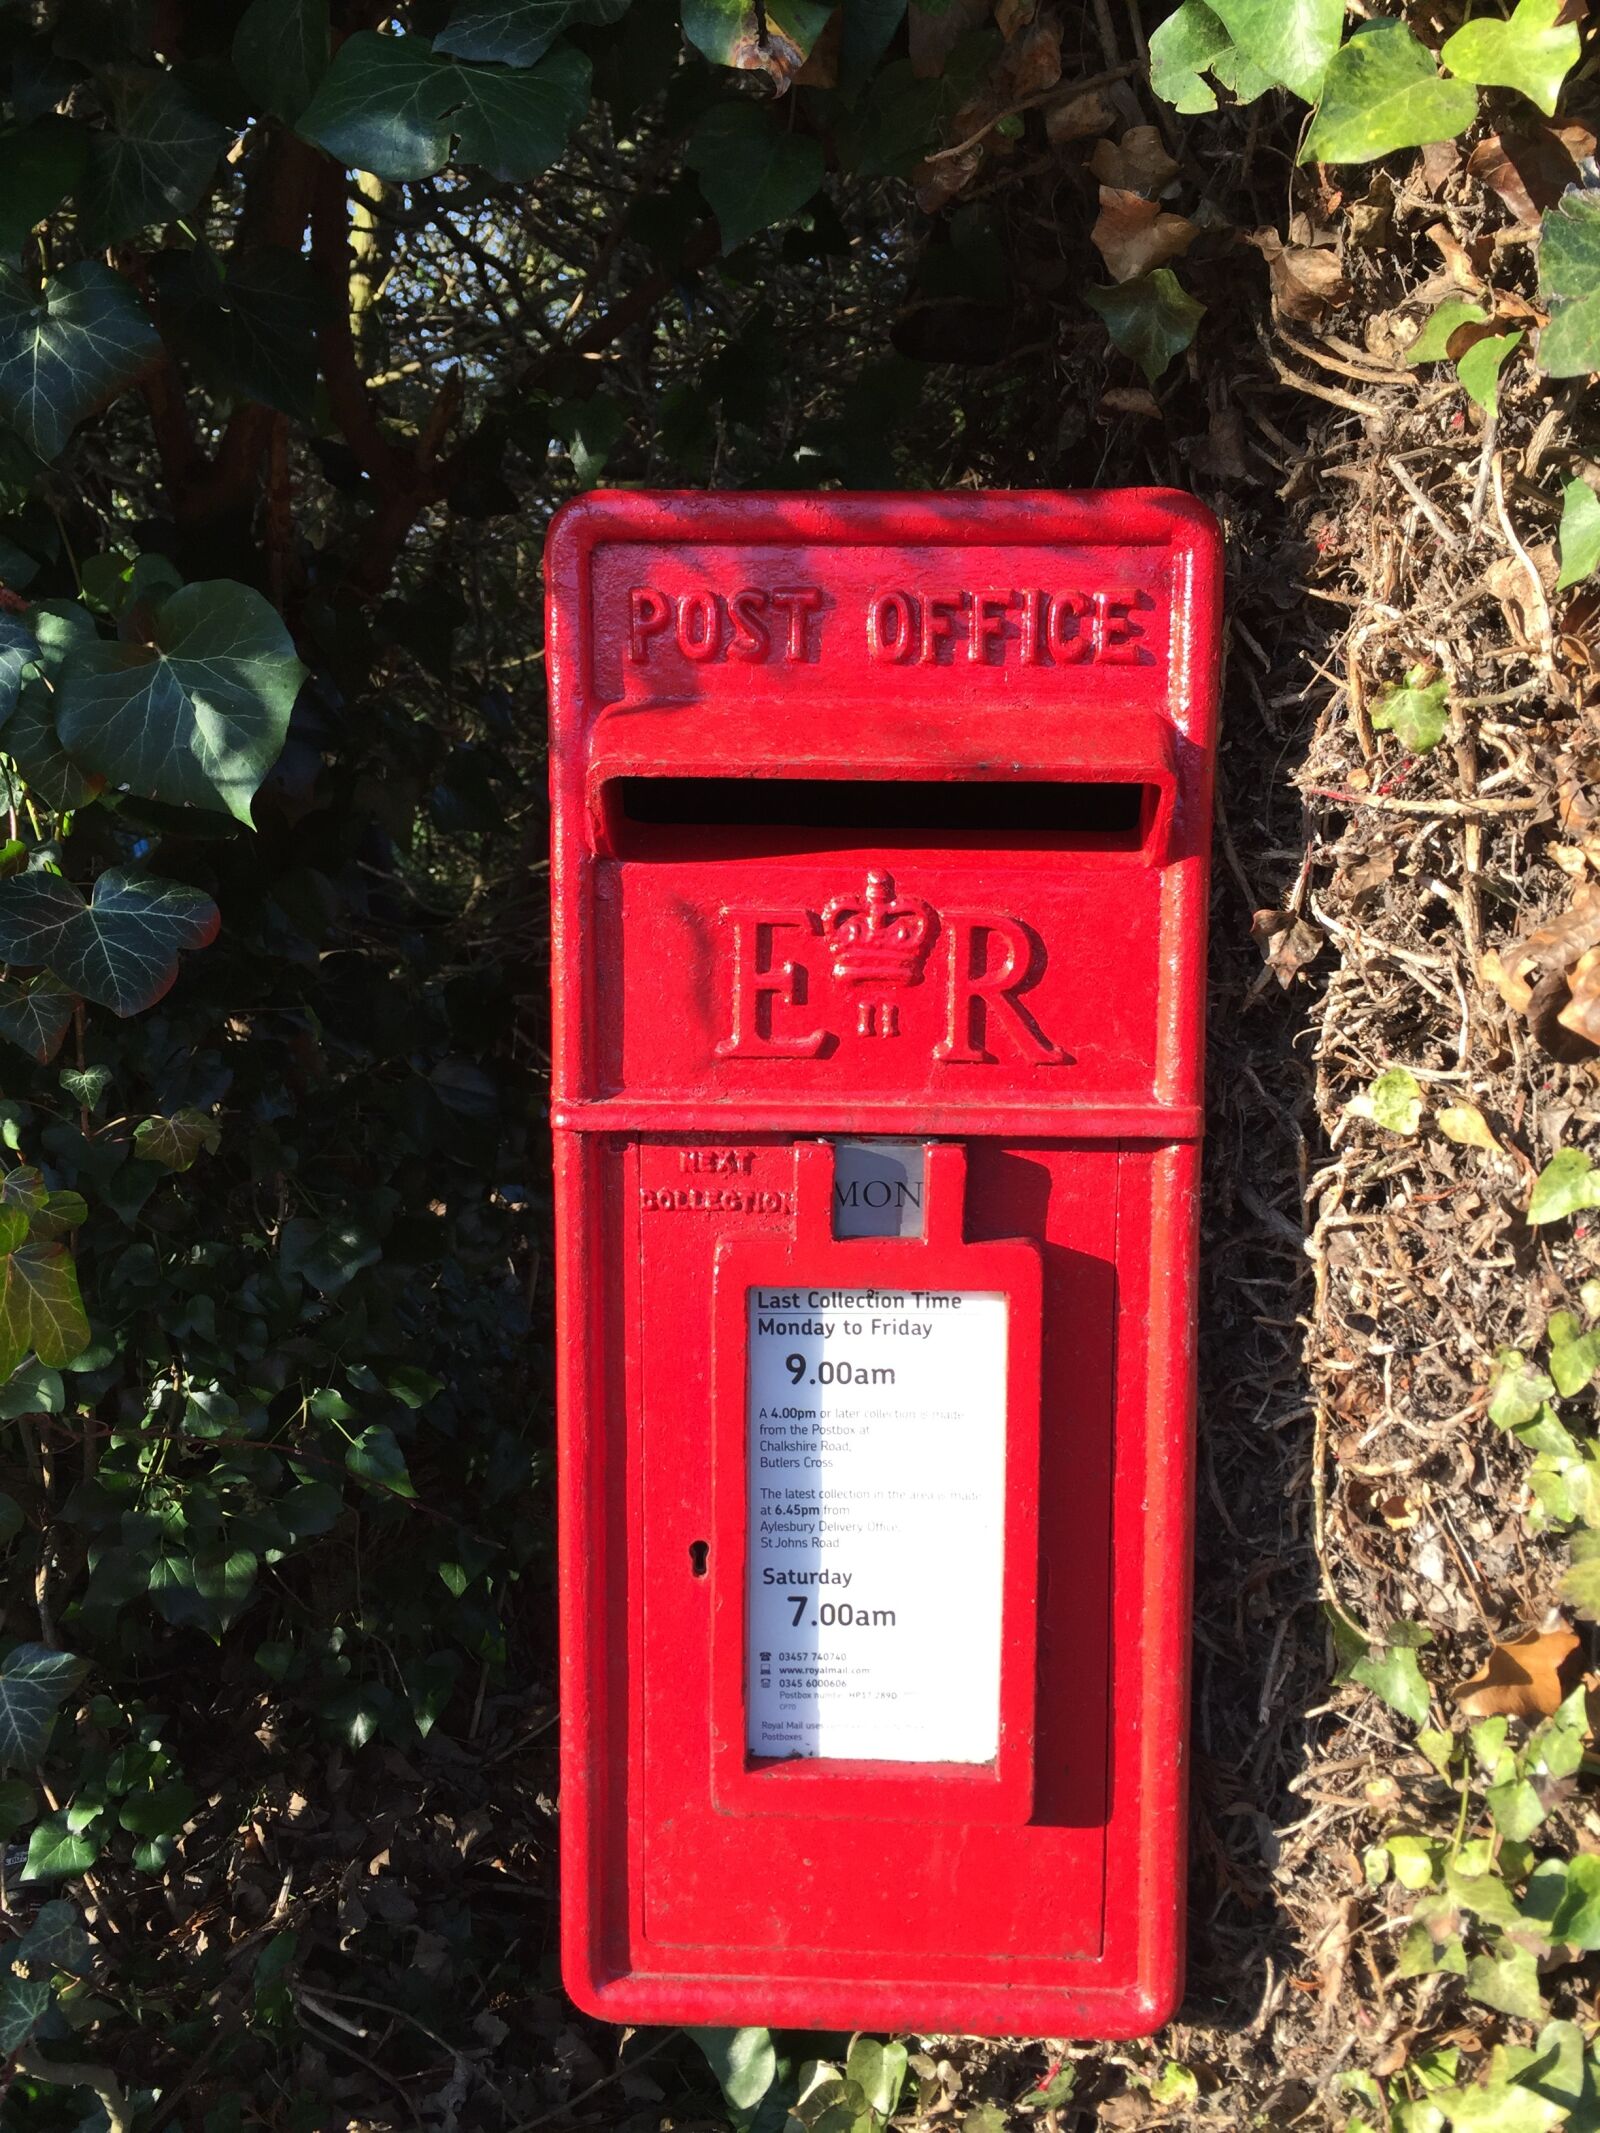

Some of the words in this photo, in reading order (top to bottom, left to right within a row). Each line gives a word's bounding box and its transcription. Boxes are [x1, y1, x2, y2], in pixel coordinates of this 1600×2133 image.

[628, 588, 826, 665] POST
[866, 589, 1154, 667] OFFICE
[716, 905, 838, 1060] E
[932, 907, 1076, 1066] R
[857, 1002, 899, 1038] II
[835, 1180, 924, 1208] MON
[757, 1292, 801, 1309] Last
[808, 1291, 905, 1309] Collection
[911, 1292, 962, 1310] Time
[757, 1319, 835, 1339] Monday
[844, 1320, 863, 1336] to
[871, 1319, 933, 1339] Friday
[785, 1353, 896, 1385] 9.00am
[759, 1408, 768, 1419] A
[770, 1408, 816, 1421] 4.00pm
[819, 1410, 831, 1419] or
[835, 1408, 860, 1419] later
[864, 1408, 916, 1419] collection
[759, 1424, 787, 1435] from
[790, 1424, 808, 1435] the
[811, 1424, 856, 1435] Postbox
[859, 1426, 870, 1435] at
[759, 1441, 817, 1452] Chalkshire
[760, 1457, 801, 1468] Butlers
[803, 1457, 834, 1468] Cross
[760, 1488, 782, 1499] The
[785, 1488, 816, 1499] latest
[818, 1488, 870, 1499] collection
[888, 1488, 906, 1500] the
[760, 1506, 771, 1516] at
[775, 1505, 820, 1517] 6.45pm
[823, 1505, 850, 1516] from
[759, 1521, 815, 1534] Aylesbury
[818, 1521, 863, 1534] Delivery
[760, 1537, 773, 1548] St
[775, 1537, 808, 1549] Johns
[811, 1537, 840, 1548] Road
[762, 1568, 852, 1588] Saturday
[787, 1596, 896, 1627] 7.00am
[778, 1652, 808, 1662] 03457
[811, 1652, 847, 1662] 740740
[778, 1666, 870, 1676] www.royalmail.com
[778, 1679, 803, 1688] 0345
[805, 1679, 847, 1688] 6000606
[779, 1690, 812, 1700] Postbox
[761, 1721, 784, 1731] Royal
[786, 1720, 804, 1729] Mail
[761, 1732, 803, 1741] Postboxes
